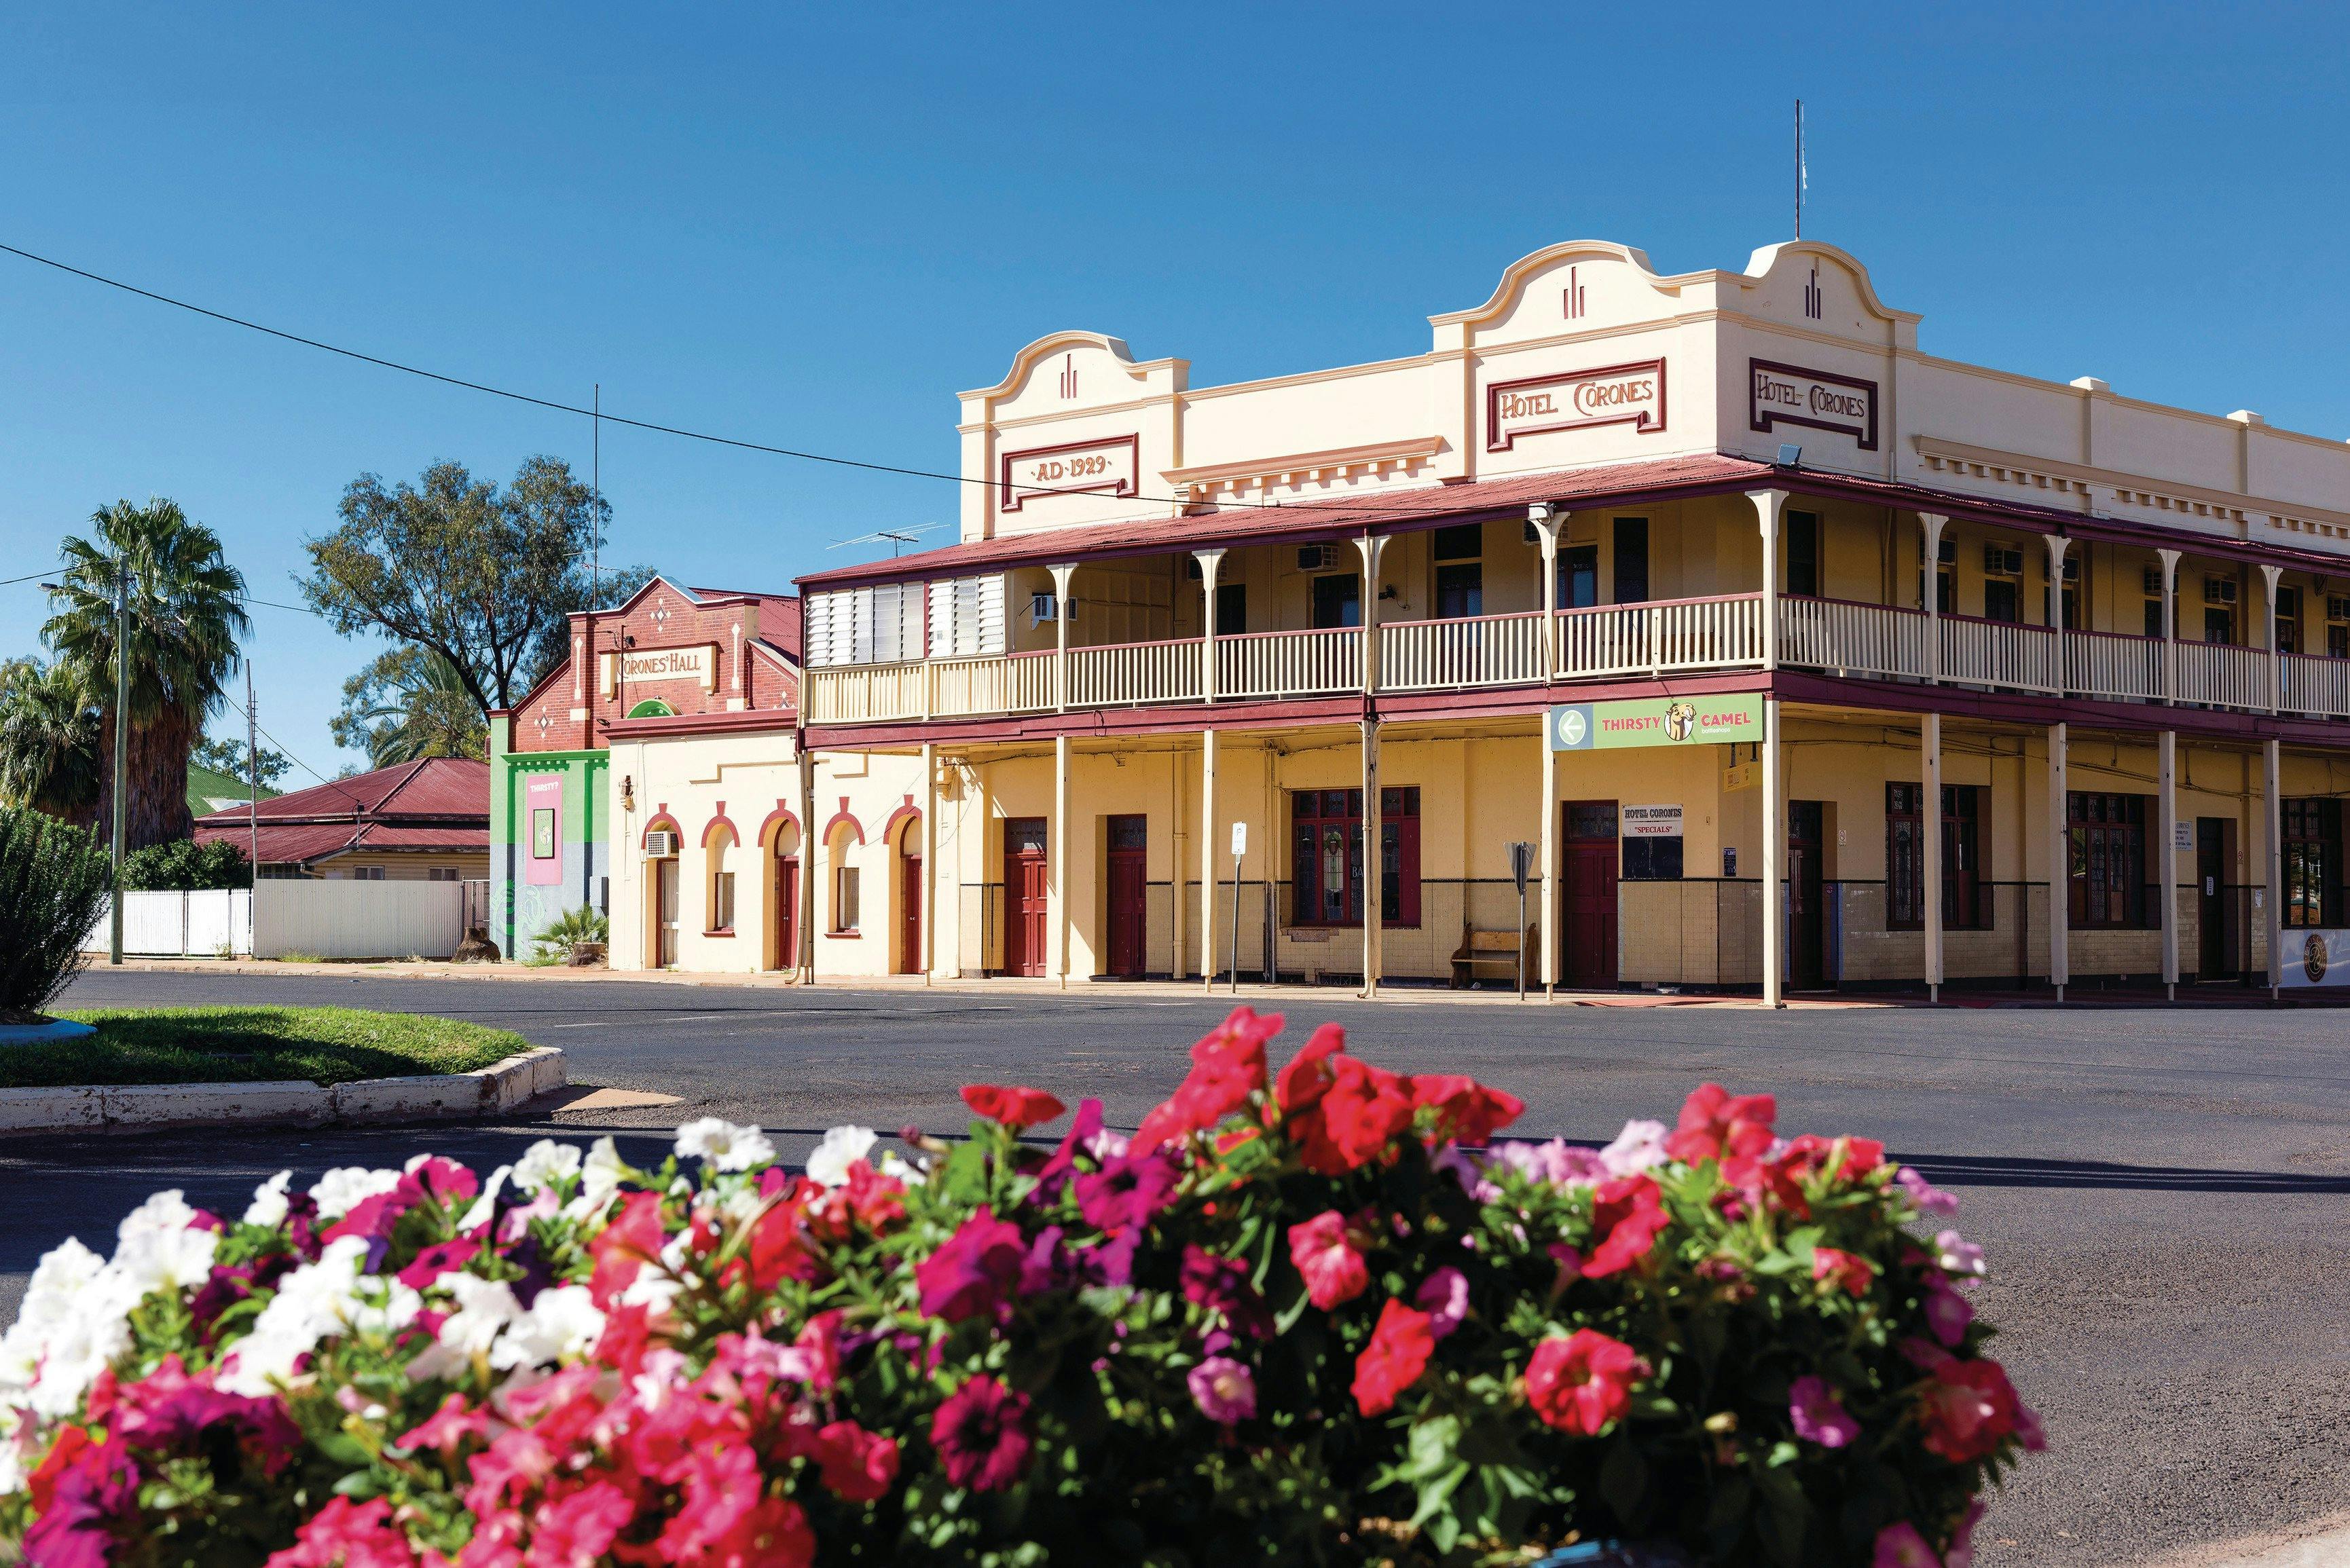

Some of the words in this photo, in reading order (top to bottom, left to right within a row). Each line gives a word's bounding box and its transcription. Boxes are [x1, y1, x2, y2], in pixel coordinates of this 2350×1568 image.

[1602, 716, 1661, 731] THIRSTY
[1700, 711, 1751, 727] CAMEL
[530, 781, 559, 794] THIRSTY?
[1624, 808, 1649, 819] HOTEL
[1649, 807, 1683, 818] CORONES
[1352, 866, 1364, 878] BA
